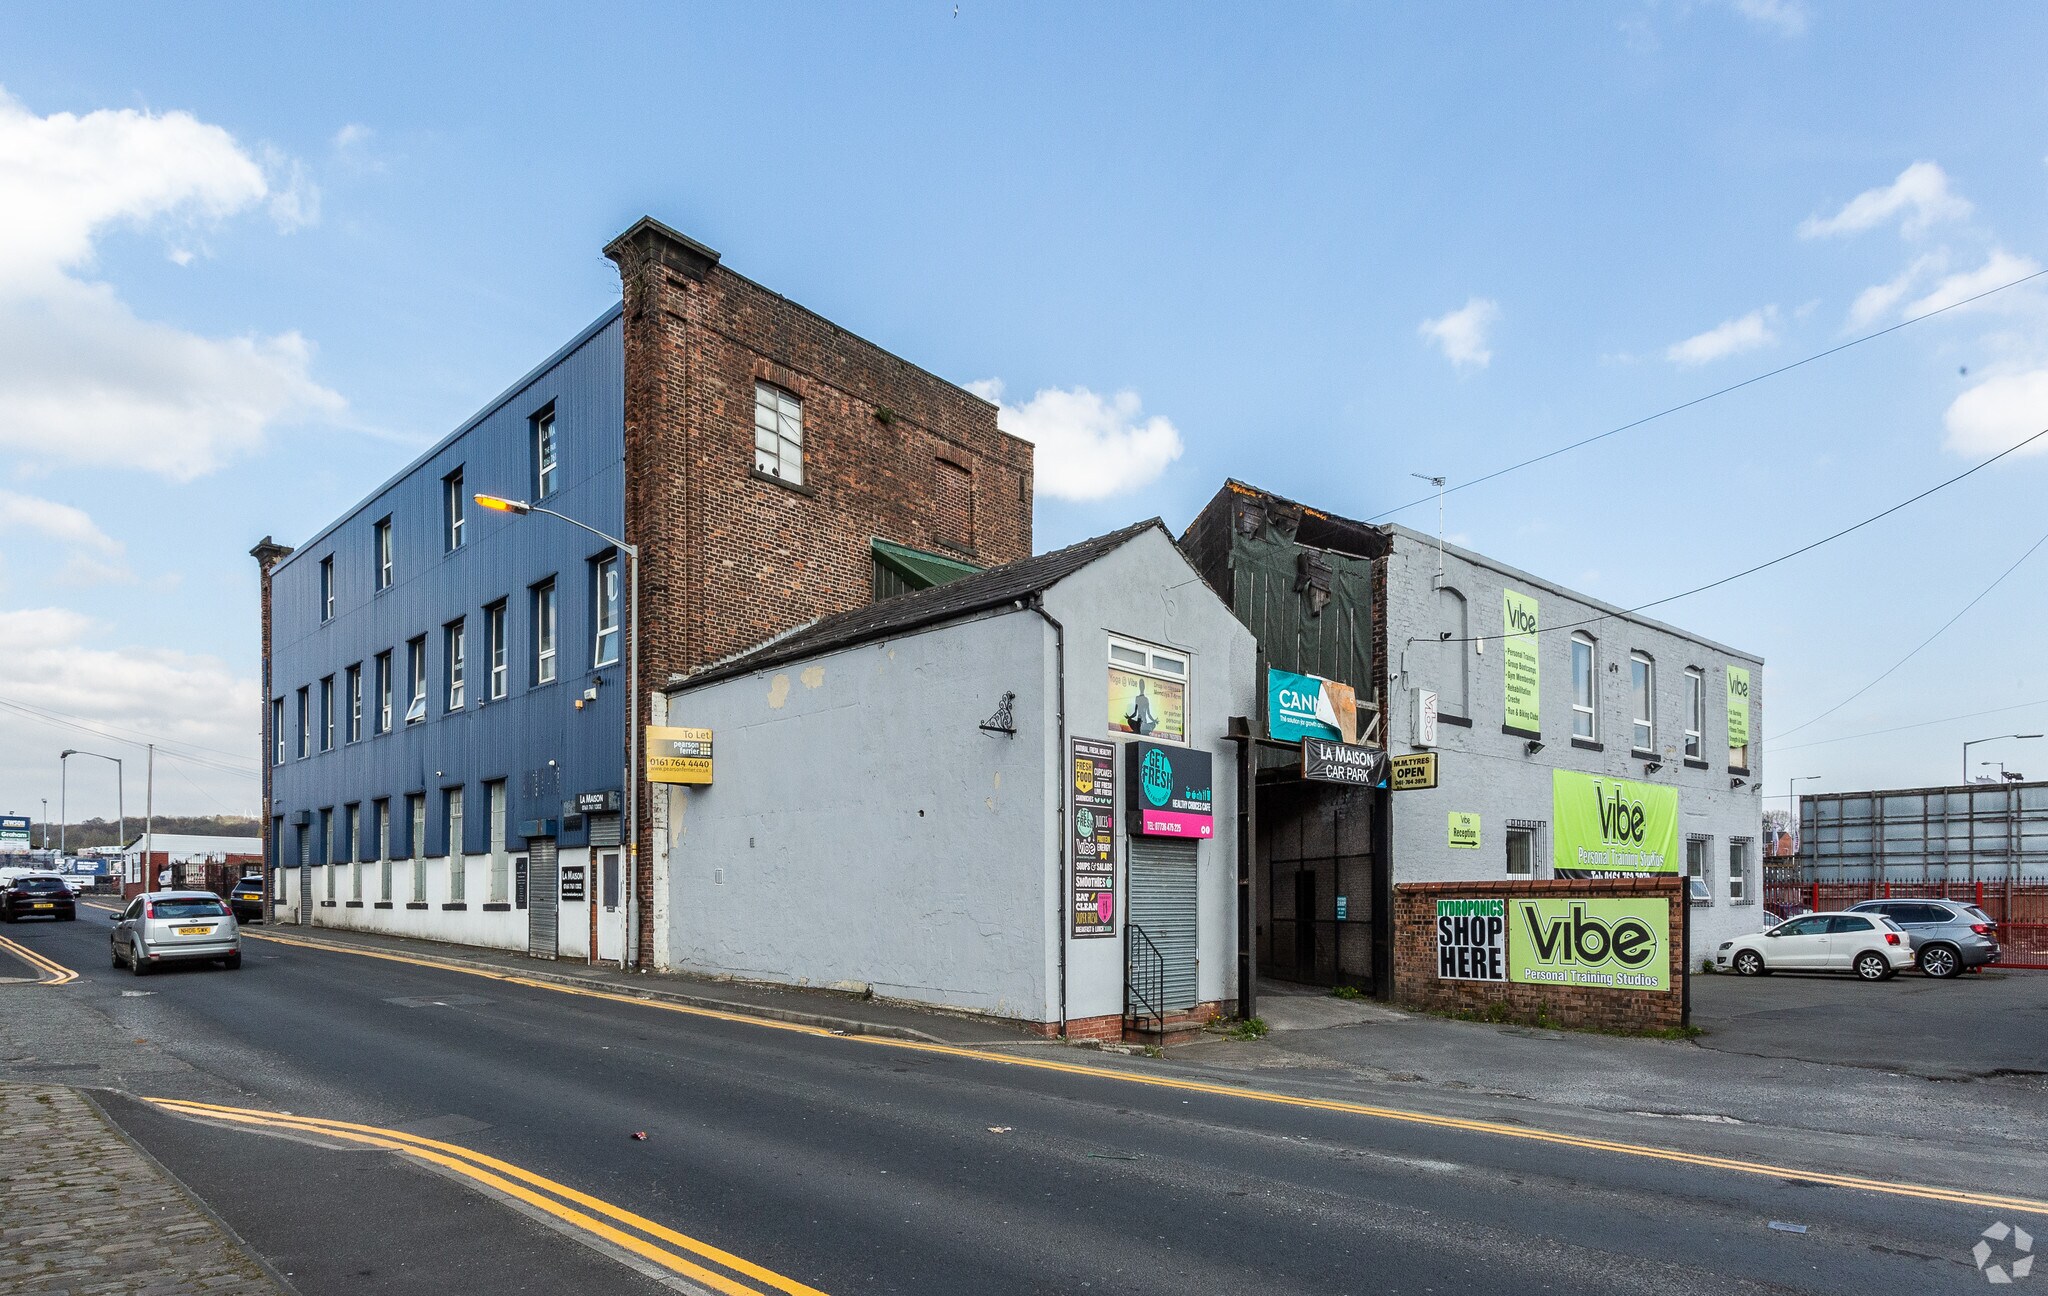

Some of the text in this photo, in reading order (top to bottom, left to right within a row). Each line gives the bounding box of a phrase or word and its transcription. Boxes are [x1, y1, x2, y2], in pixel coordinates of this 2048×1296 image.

[1506, 599, 1536, 634] Vibe
[1508, 648, 1536, 664] Personal Training
[1508, 660, 1536, 674] Group Bootcamps
[1109, 674, 1137, 688] Yoga @ Vibe
[1516, 673, 1536, 686] Membership
[1728, 673, 1748, 697] Vibe
[1508, 684, 1531, 696] Rehabilitation
[1508, 695, 1520, 704] Creche
[1424, 694, 1437, 742] Vibe
[1519, 709, 1529, 720] Biking
[1530, 712, 1538, 720] Clubs
[1150, 750, 1165, 770] GET
[1320, 744, 1374, 768] LA MAISON
[1077, 762, 1091, 771] FRESH
[1094, 768, 1112, 777] CUPCAKES
[1326, 764, 1369, 782] CAR PARK
[1397, 767, 1425, 778] OPEN
[1077, 771, 1091, 783] FOOD
[1142, 764, 1172, 790] FRESH
[1172, 799, 1211, 811] HEALTHY CHOICES CAFE
[1460, 815, 1470, 825] Vibe
[1594, 782, 1646, 846] Vibe
[1454, 827, 1476, 839] Reception
[1076, 839, 1096, 855] Vibe
[1097, 843, 1111, 851] ENERGY
[1578, 846, 1664, 869] Personal Training Studios
[1076, 862, 1112, 871] SOUPS & SALADS
[1076, 876, 1105, 887] SMOOTHIES
[1076, 893, 1089, 901] EAT
[1076, 903, 1098, 911] CLEAN
[1437, 900, 1504, 916] HYDROPONICS
[1439, 916, 1503, 946] SHOP
[1522, 904, 1656, 968] Vibe
[1440, 946, 1502, 979] HERE
[1524, 968, 1658, 986] Personal Training Studios
